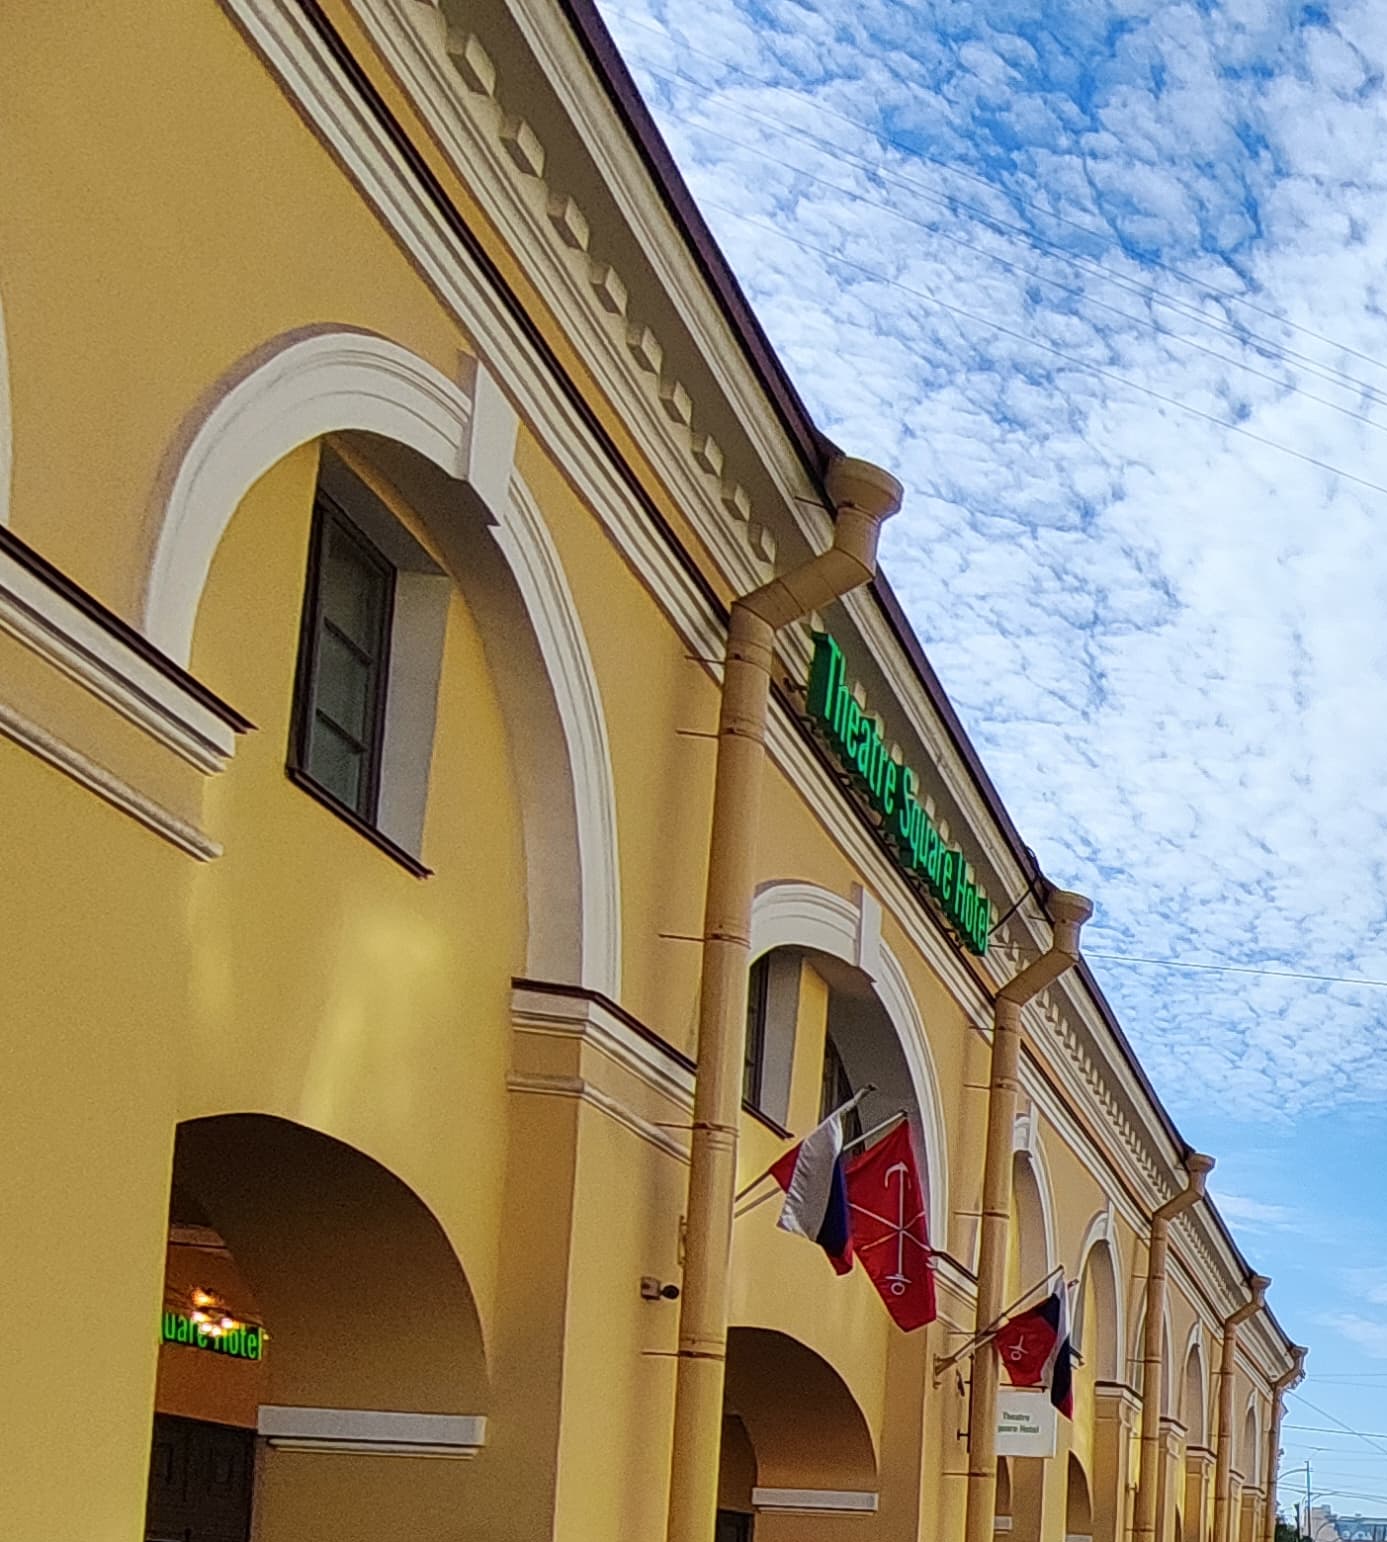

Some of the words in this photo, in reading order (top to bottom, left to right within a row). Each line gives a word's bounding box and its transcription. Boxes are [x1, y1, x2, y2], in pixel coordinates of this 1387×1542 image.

[824, 635, 897, 815] Theatre
[899, 766, 954, 900] Square
[954, 854, 991, 955] Hotel
[162, 1312, 208, 1348] uare
